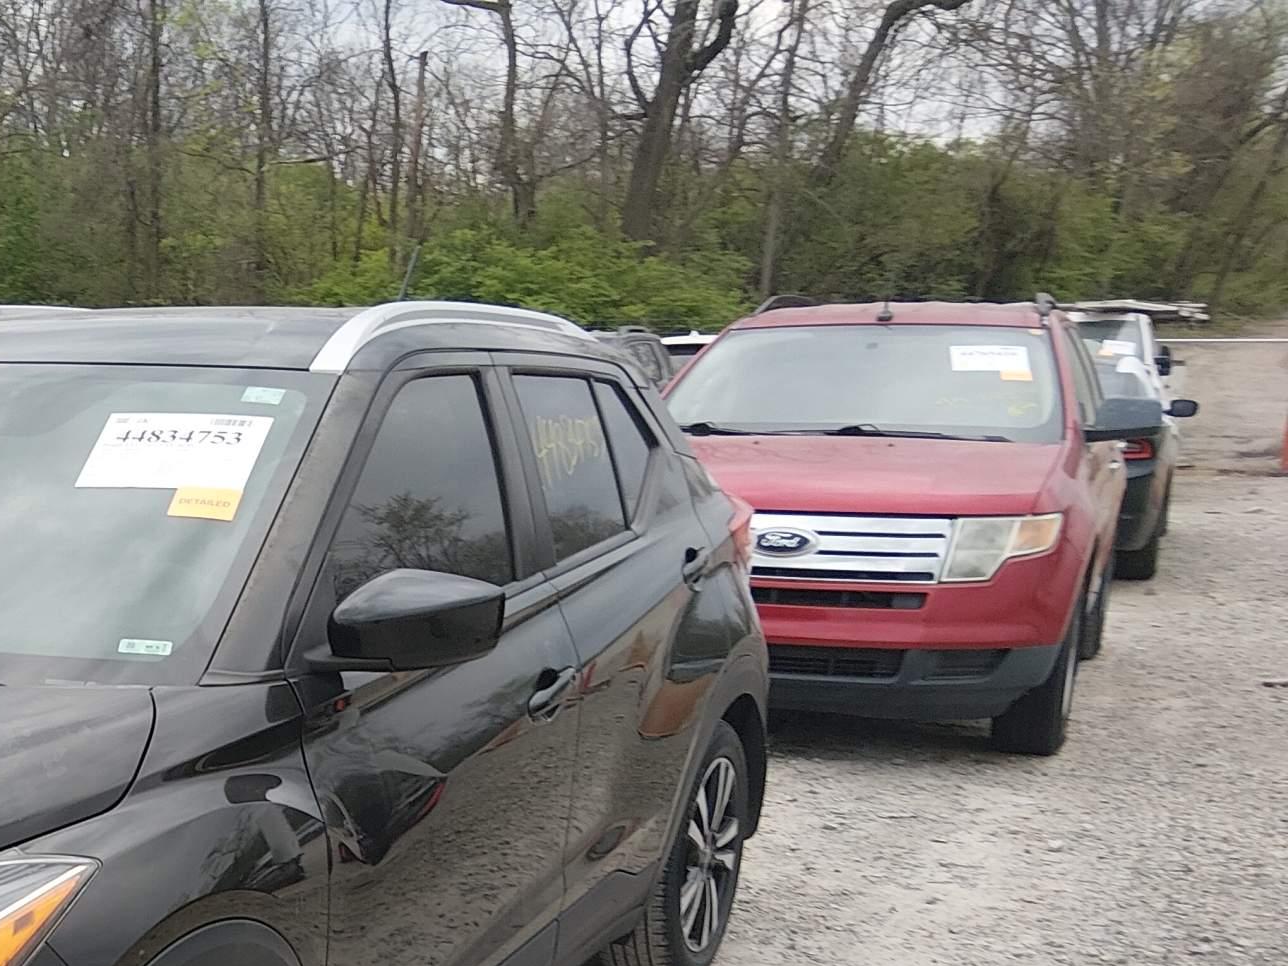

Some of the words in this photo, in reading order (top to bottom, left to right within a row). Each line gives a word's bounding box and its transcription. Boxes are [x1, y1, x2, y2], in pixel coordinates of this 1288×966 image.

[115, 429, 243, 445] 44834753
[178, 497, 231, 509] DETAILED
[760, 533, 802, 548] Ford
